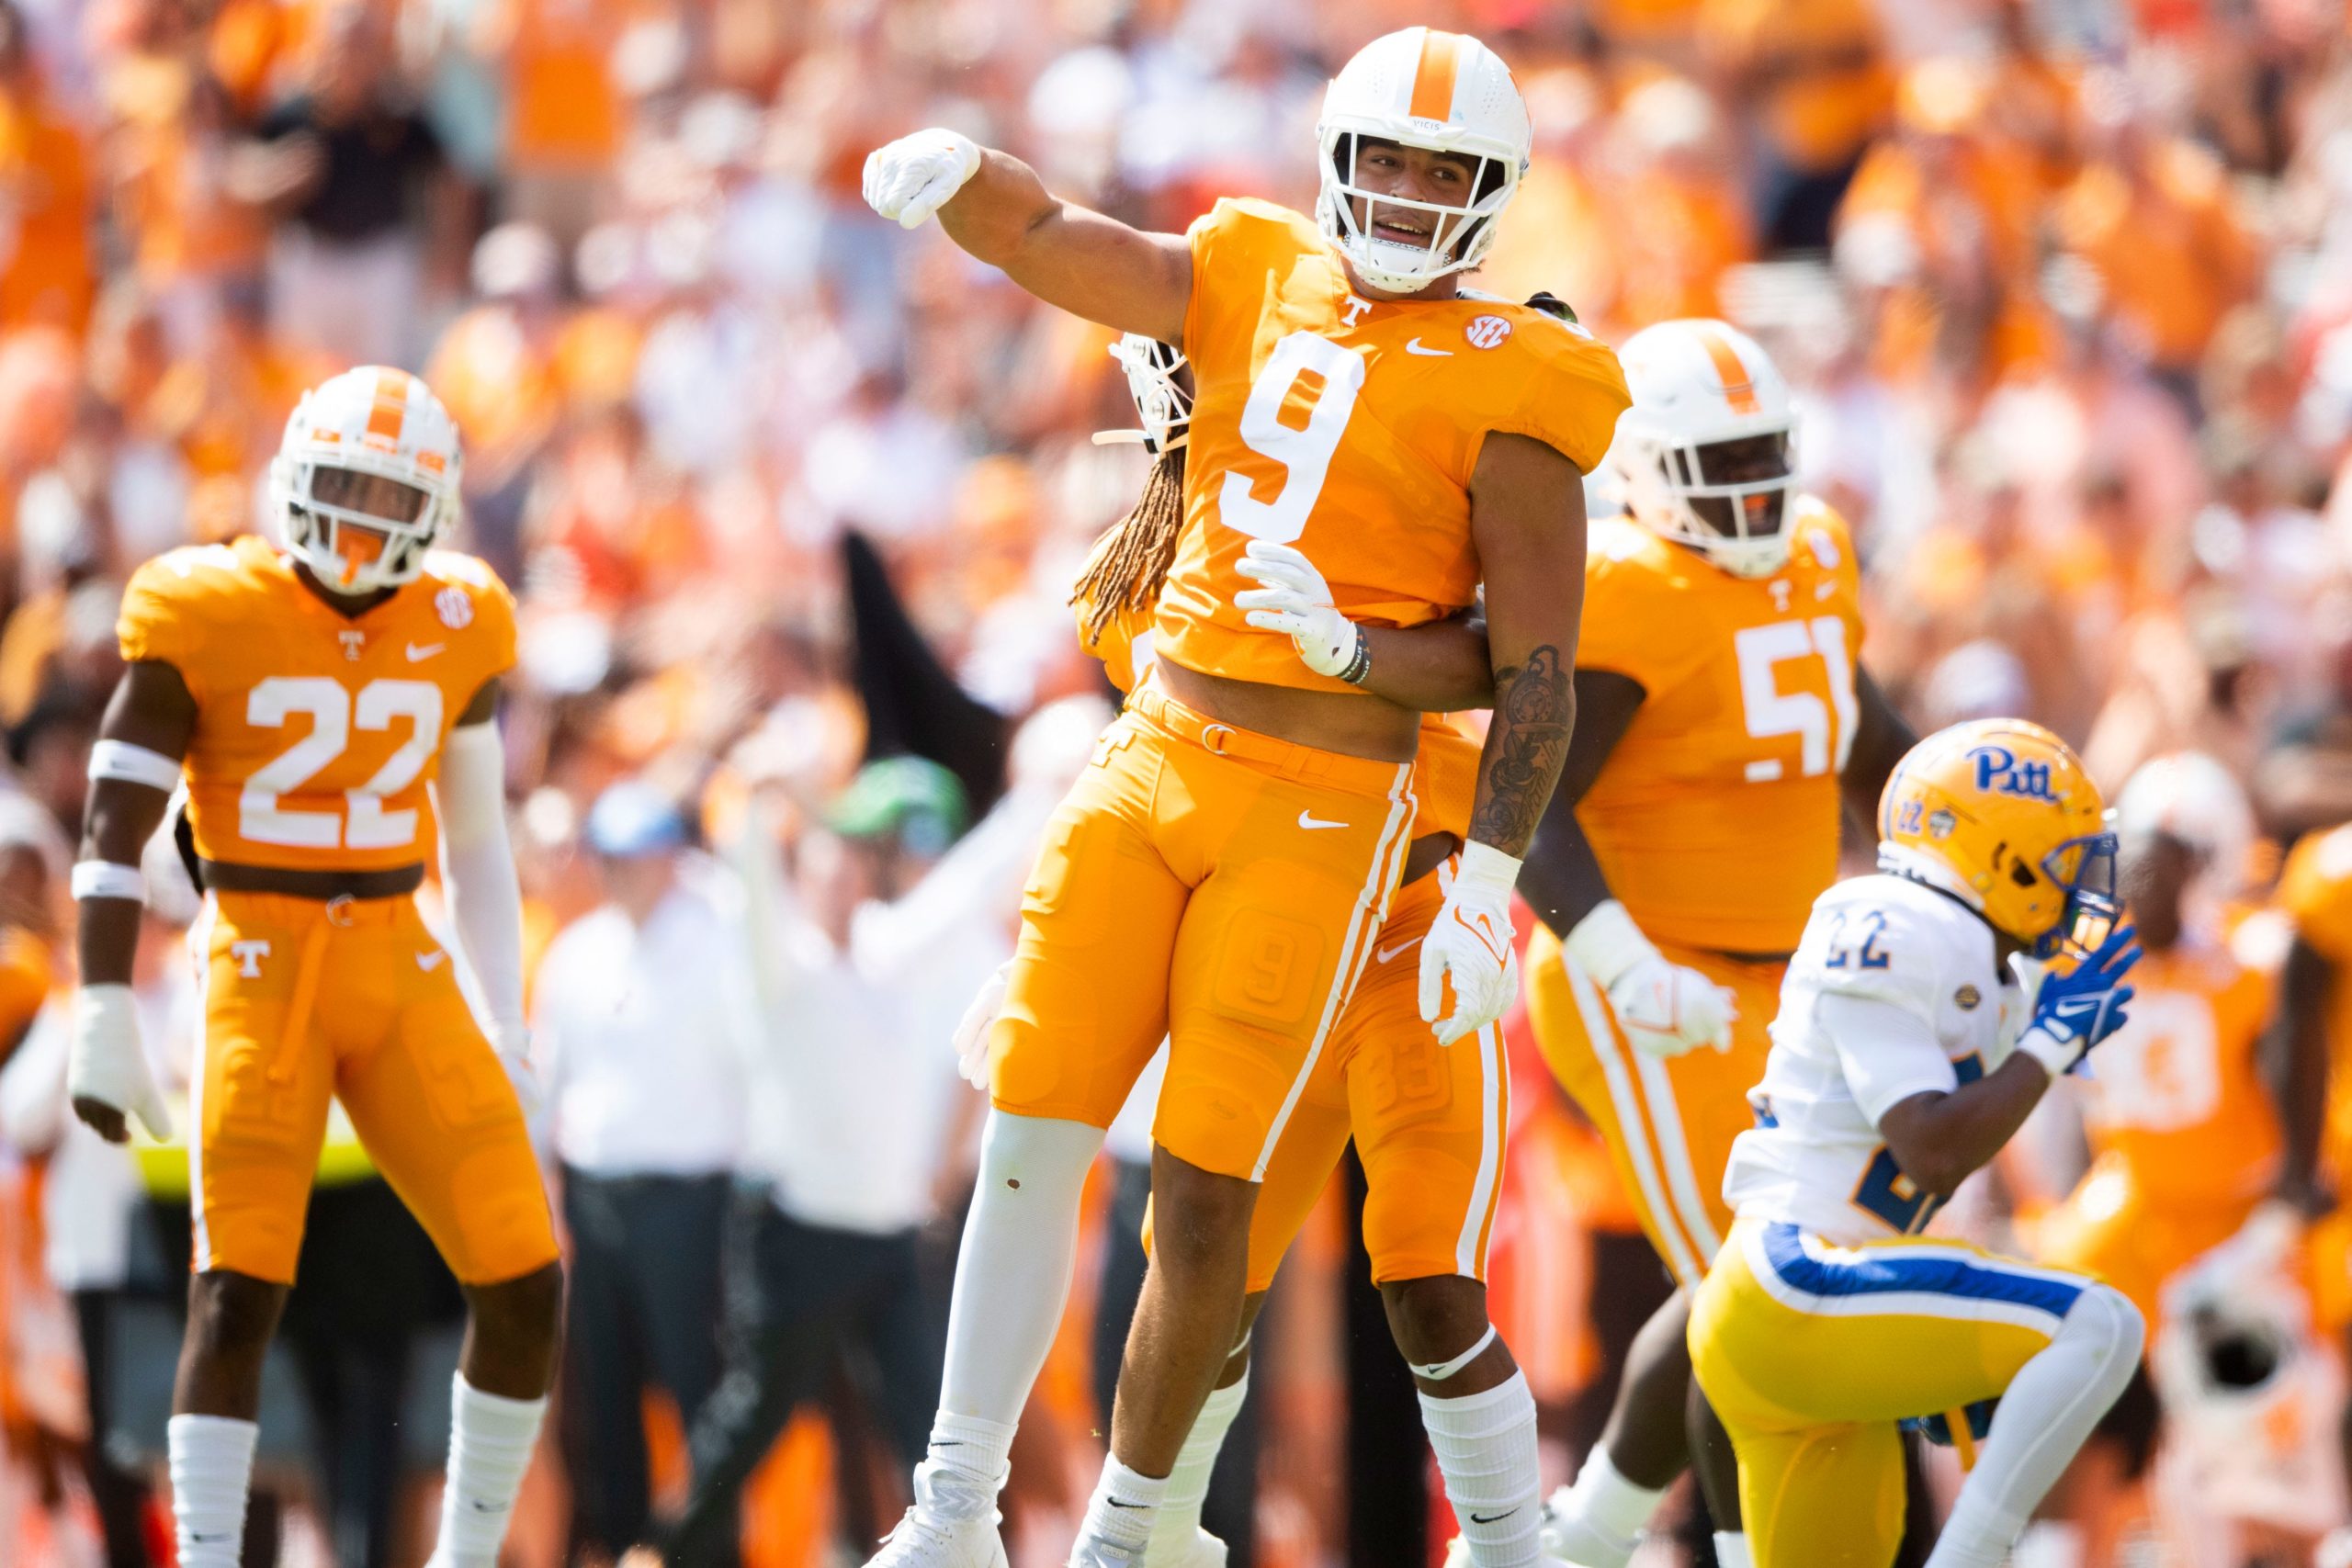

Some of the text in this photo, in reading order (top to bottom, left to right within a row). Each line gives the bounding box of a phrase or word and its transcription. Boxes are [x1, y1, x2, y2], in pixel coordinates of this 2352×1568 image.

[1413, 119, 1441, 130] VICIS
[1340, 295, 1373, 328] T
[1466, 315, 1511, 349] SEC
[1218, 330, 1365, 544] 9
[1734, 615, 1860, 783] 51
[238, 675, 444, 849] 22
[1963, 746, 2058, 803] Pitt
[231, 940, 270, 977] T
[1245, 933, 1294, 1003] 9
[1826, 910, 1890, 969] 22
